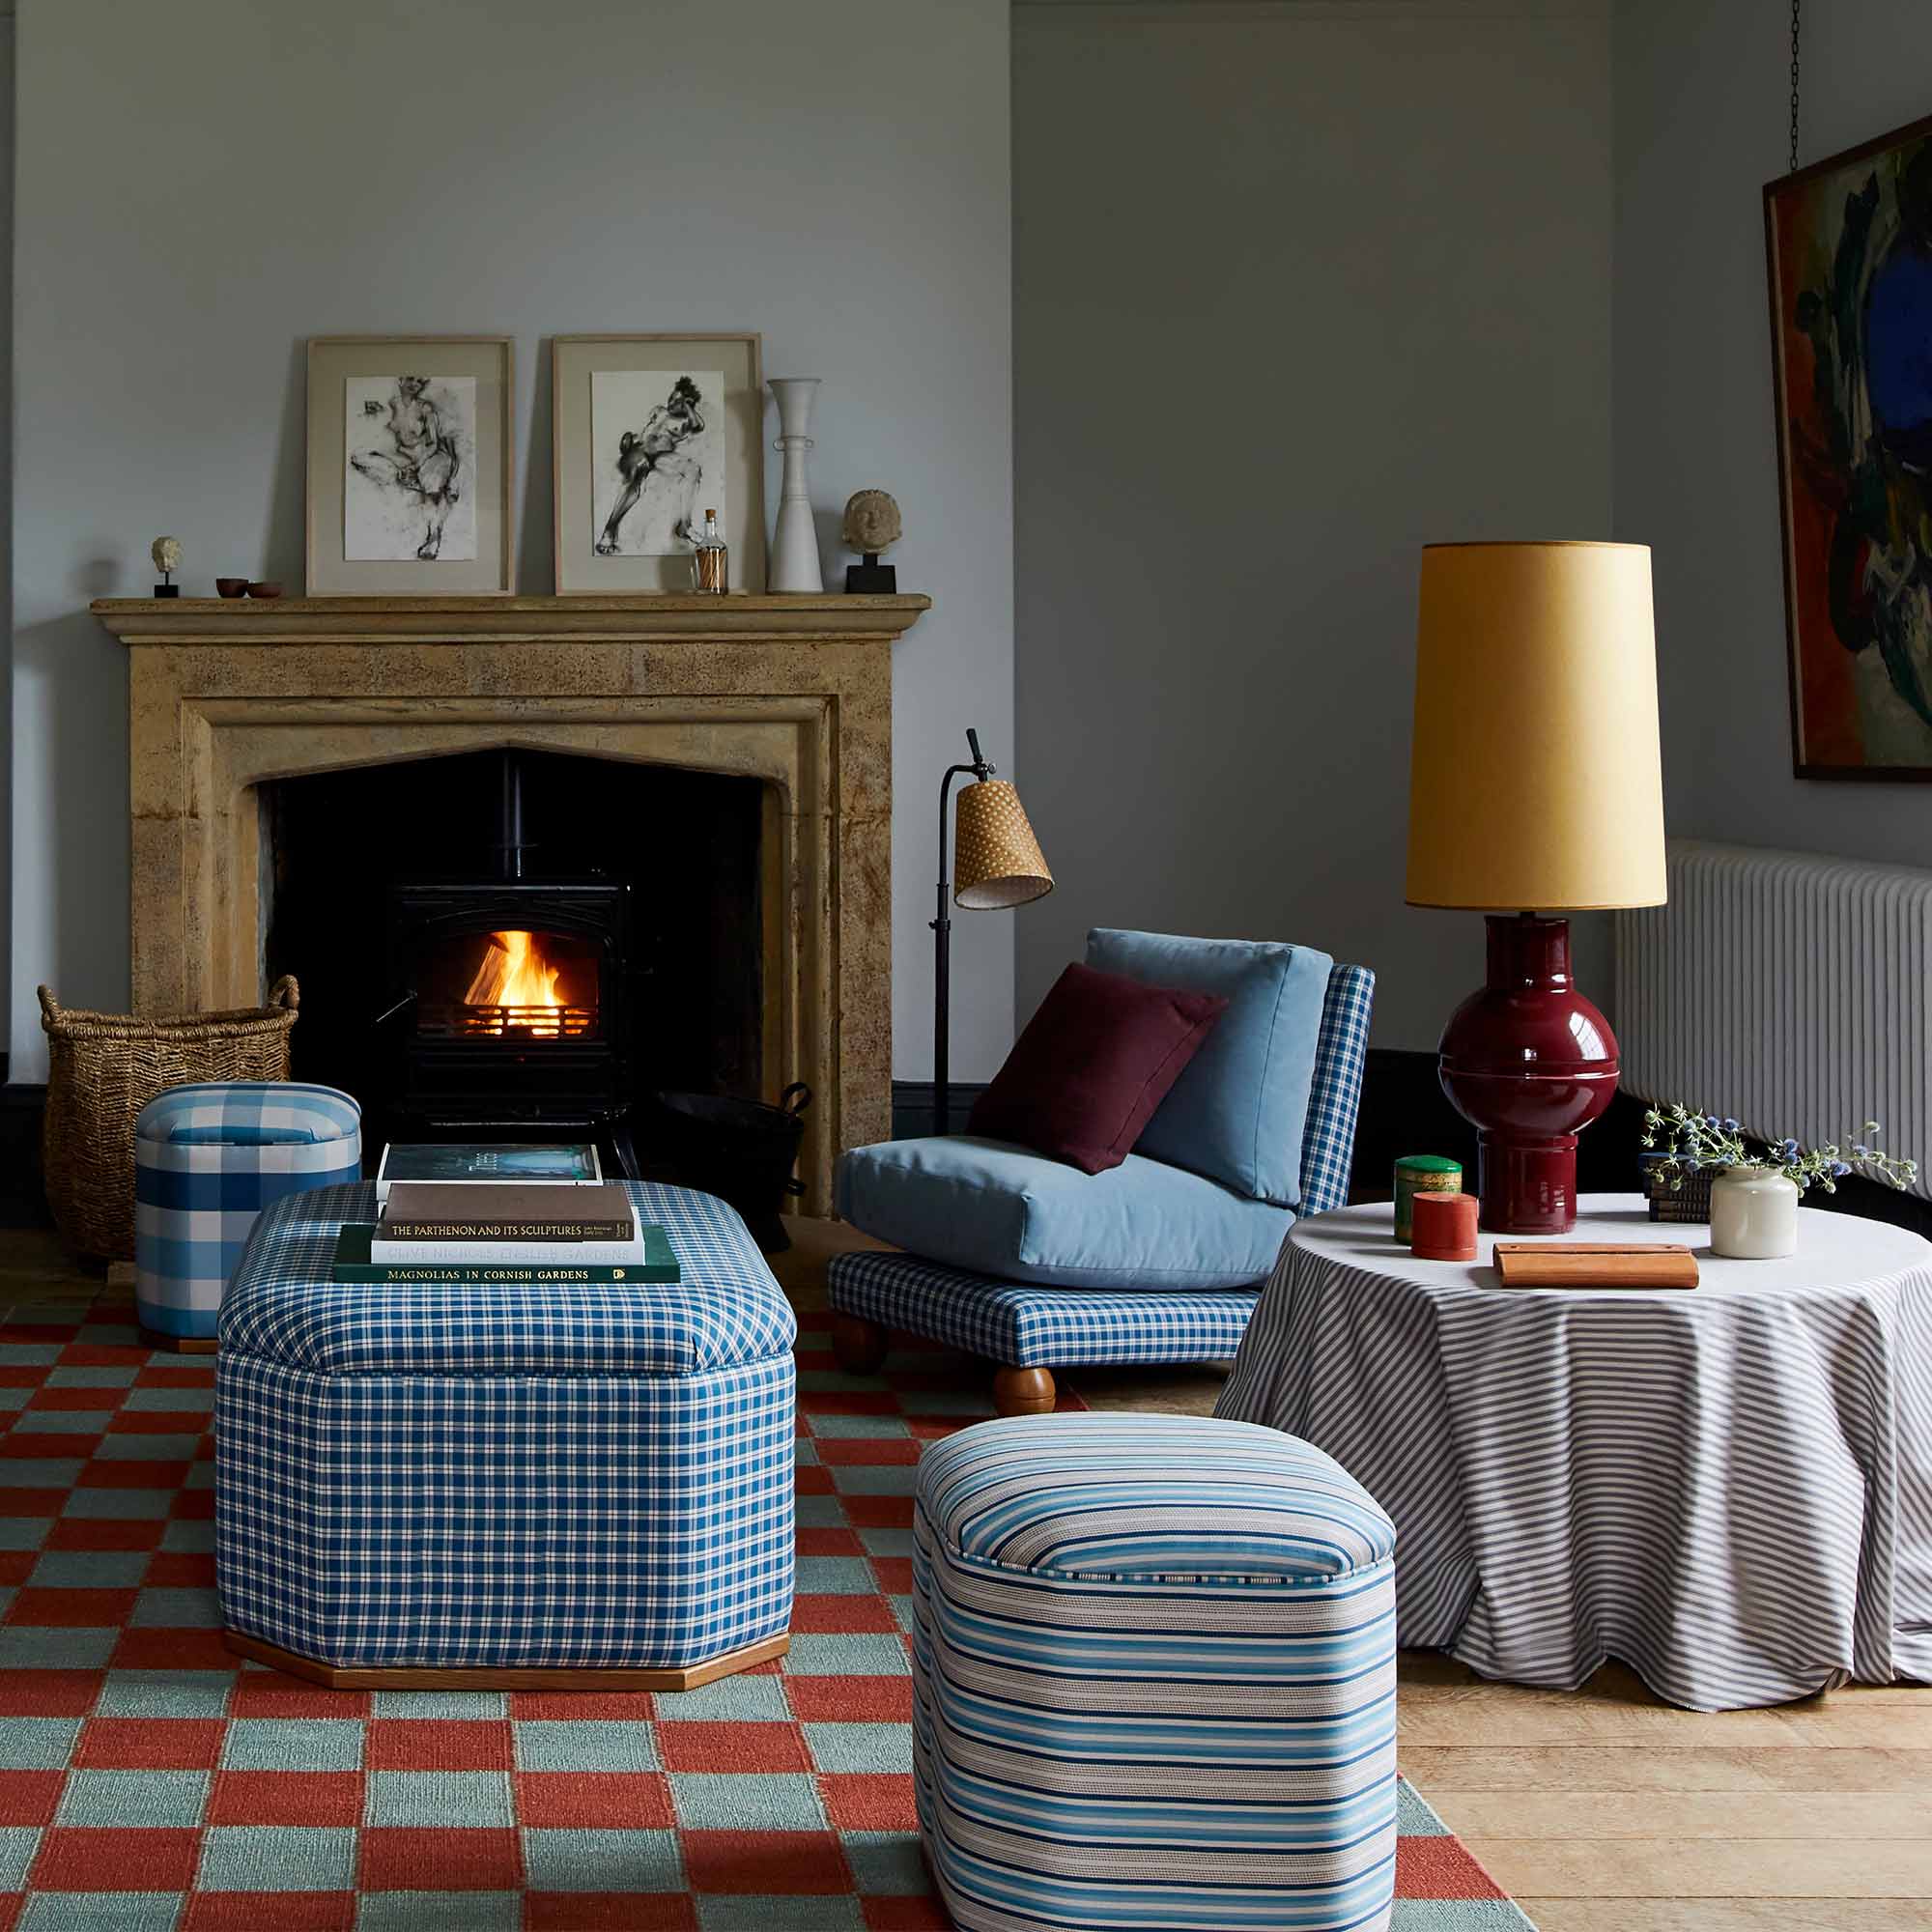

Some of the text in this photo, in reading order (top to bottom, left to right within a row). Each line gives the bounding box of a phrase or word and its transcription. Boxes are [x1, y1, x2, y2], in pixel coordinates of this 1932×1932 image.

[392, 1225, 412, 1236] THE
[414, 1225, 476, 1236] PARTHENON
[477, 1225, 501, 1236] AND
[503, 1225, 519, 1236] ITS
[521, 1225, 582, 1236] SCULPTURES
[387, 1270, 589, 1280] MAGNOLIAS IN CORNISH GARDENS
